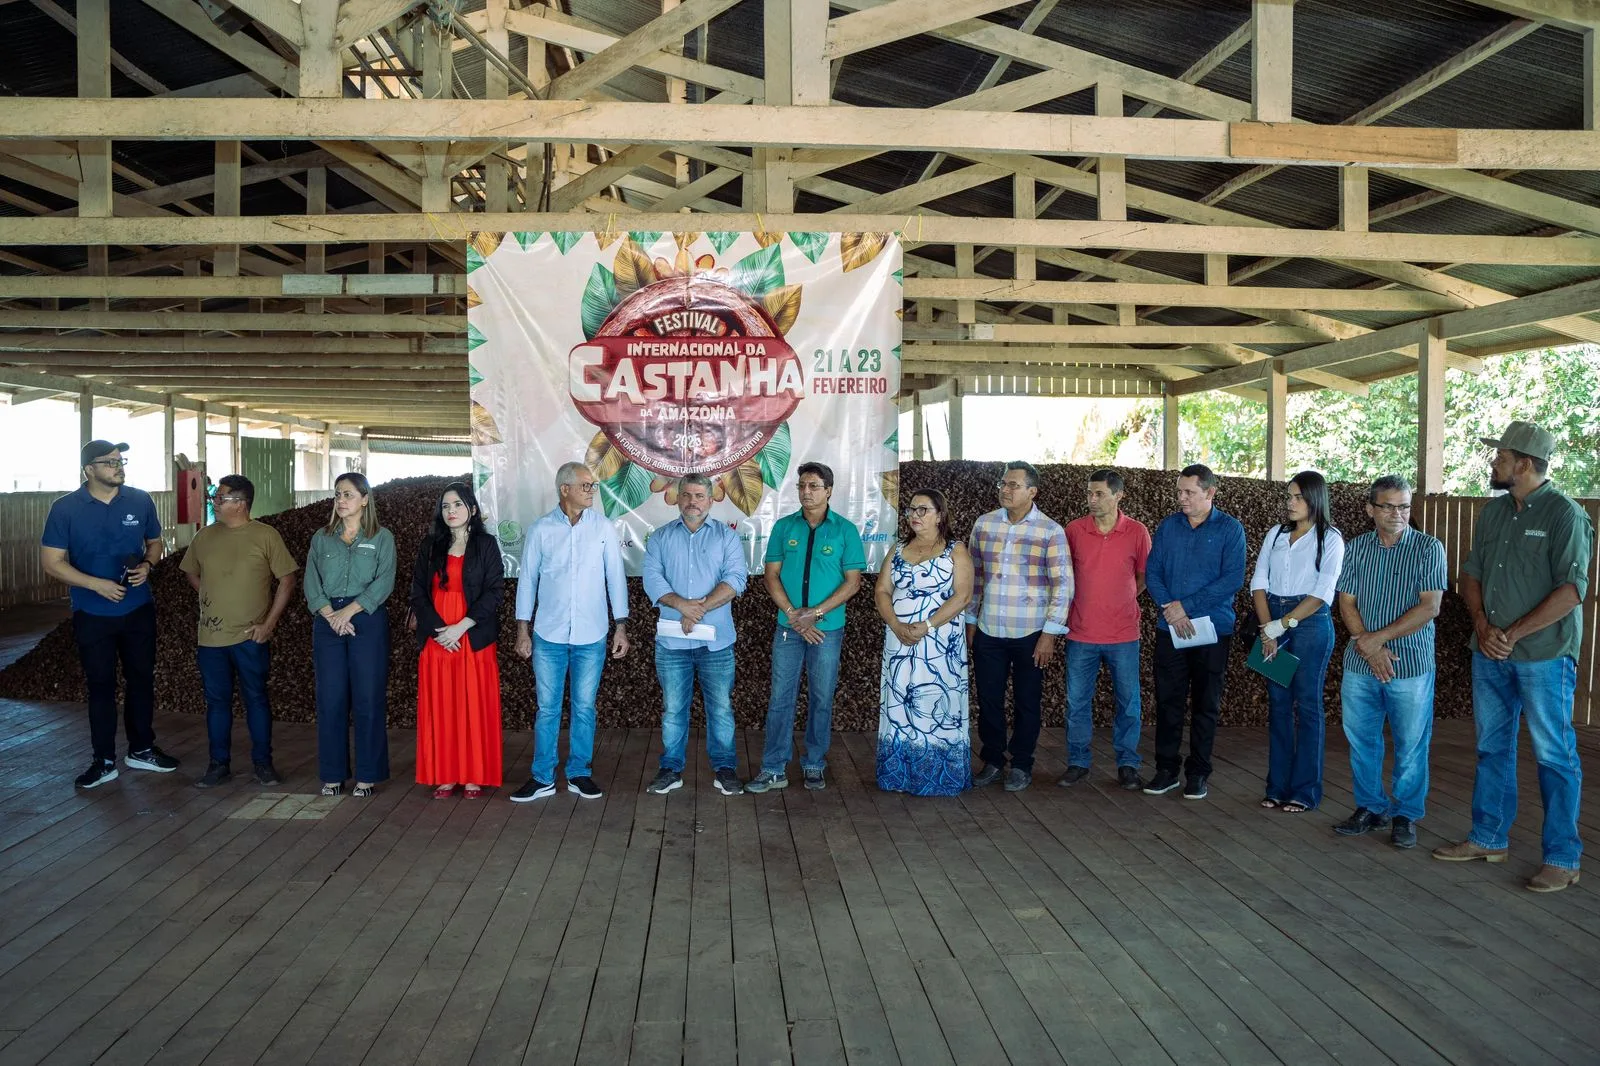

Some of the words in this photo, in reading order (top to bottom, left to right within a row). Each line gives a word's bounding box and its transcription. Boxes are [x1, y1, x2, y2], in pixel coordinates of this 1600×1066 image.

[654, 311, 720, 335] FESTIVAL
[627, 341, 741, 357] INTERNACIONAL
[745, 343, 766, 356] DA
[814, 349, 833, 373] 21
[839, 349, 852, 373] A
[857, 349, 882, 373] 23
[570, 346, 805, 405] CASTANHA
[813, 377, 887, 394] FEVEREIRO
[640, 408, 653, 418] DA
[657, 405, 736, 420] AMAZÔNIA
[614, 432, 622, 440] A
[619, 438, 640, 458] FORÇA
[640, 454, 652, 465] DO
[722, 431, 764, 466] COOPERATIVO
